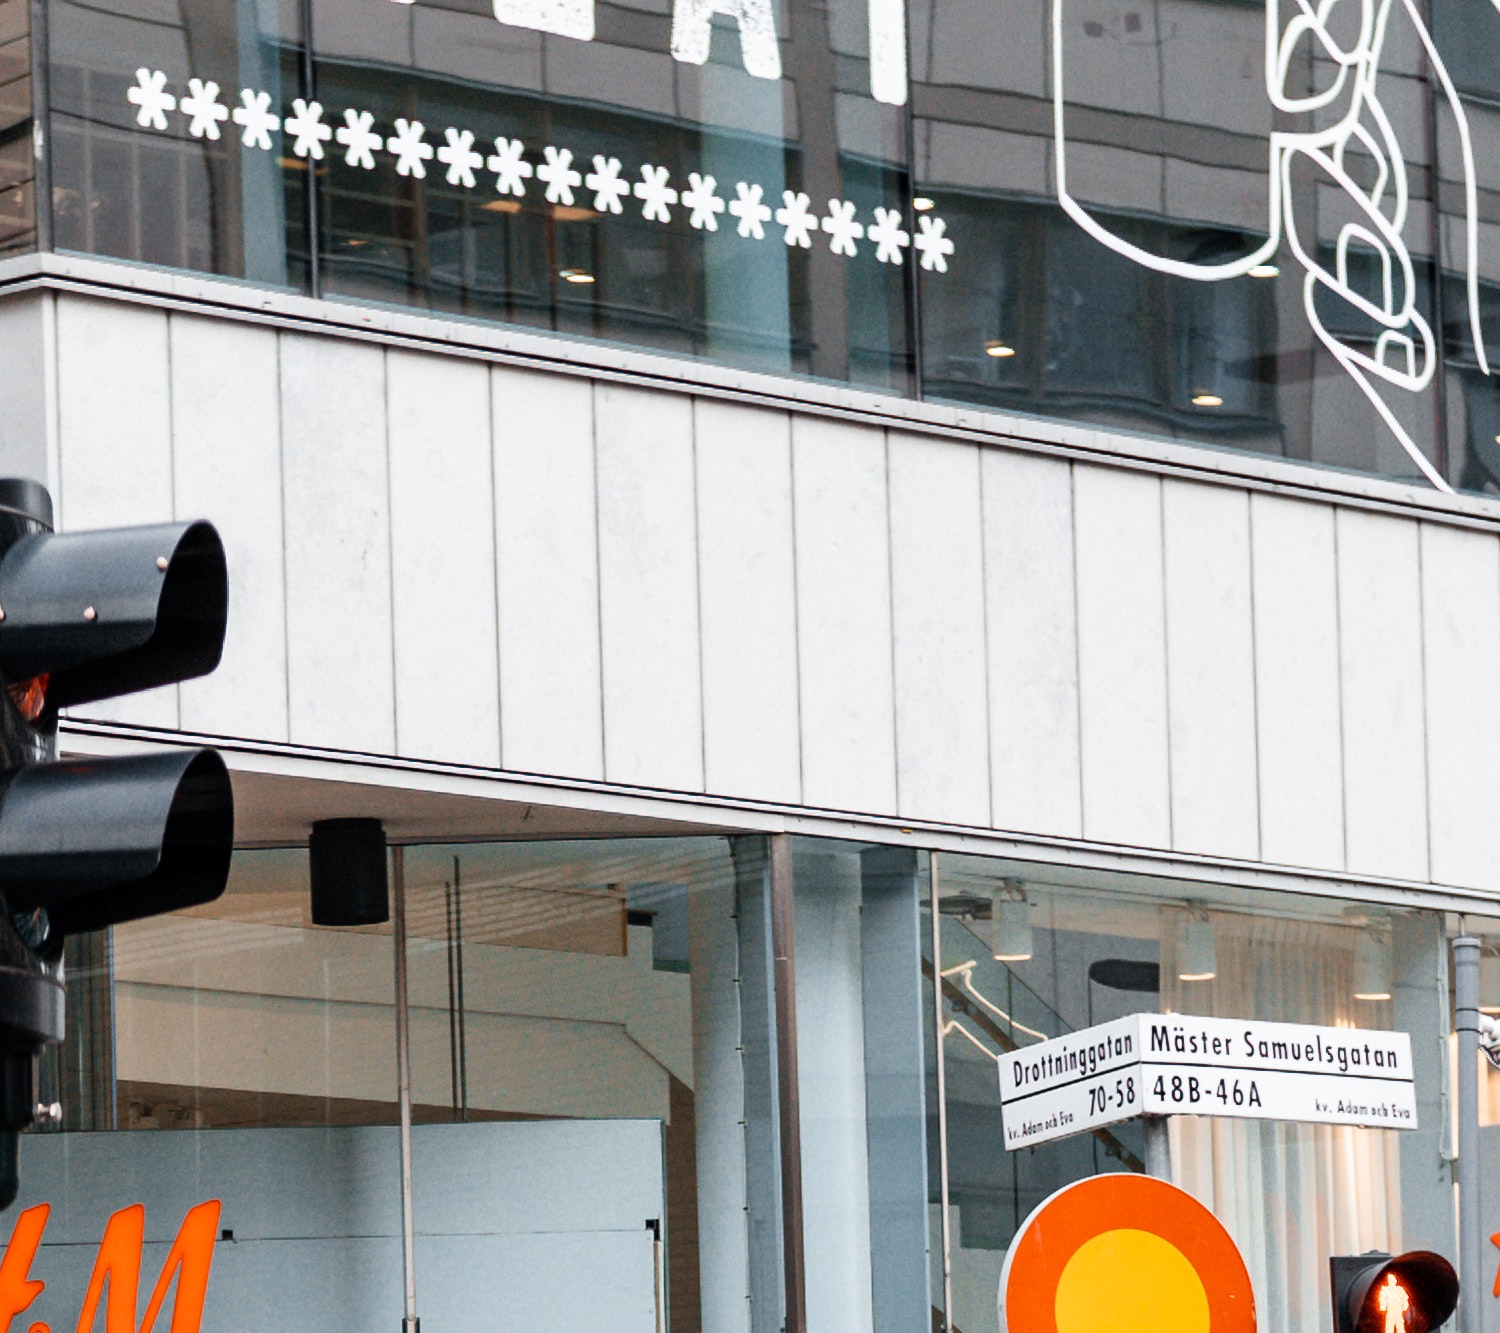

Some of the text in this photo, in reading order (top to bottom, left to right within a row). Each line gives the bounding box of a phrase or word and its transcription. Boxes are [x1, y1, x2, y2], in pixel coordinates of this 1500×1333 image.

[1013, 1034, 1132, 1087] Drottninggatan
[1151, 1025, 1398, 1072] Mäster Samuelsgatan
[1088, 1077, 1135, 1116] 70-58
[1153, 1075, 1262, 1107] 48B-46A
[1022, 1119, 1044, 1138] Adam
[1060, 1111, 1074, 1127] Eva
[1337, 1103, 1368, 1116] Adam
[1392, 1105, 1411, 1119] Eva
